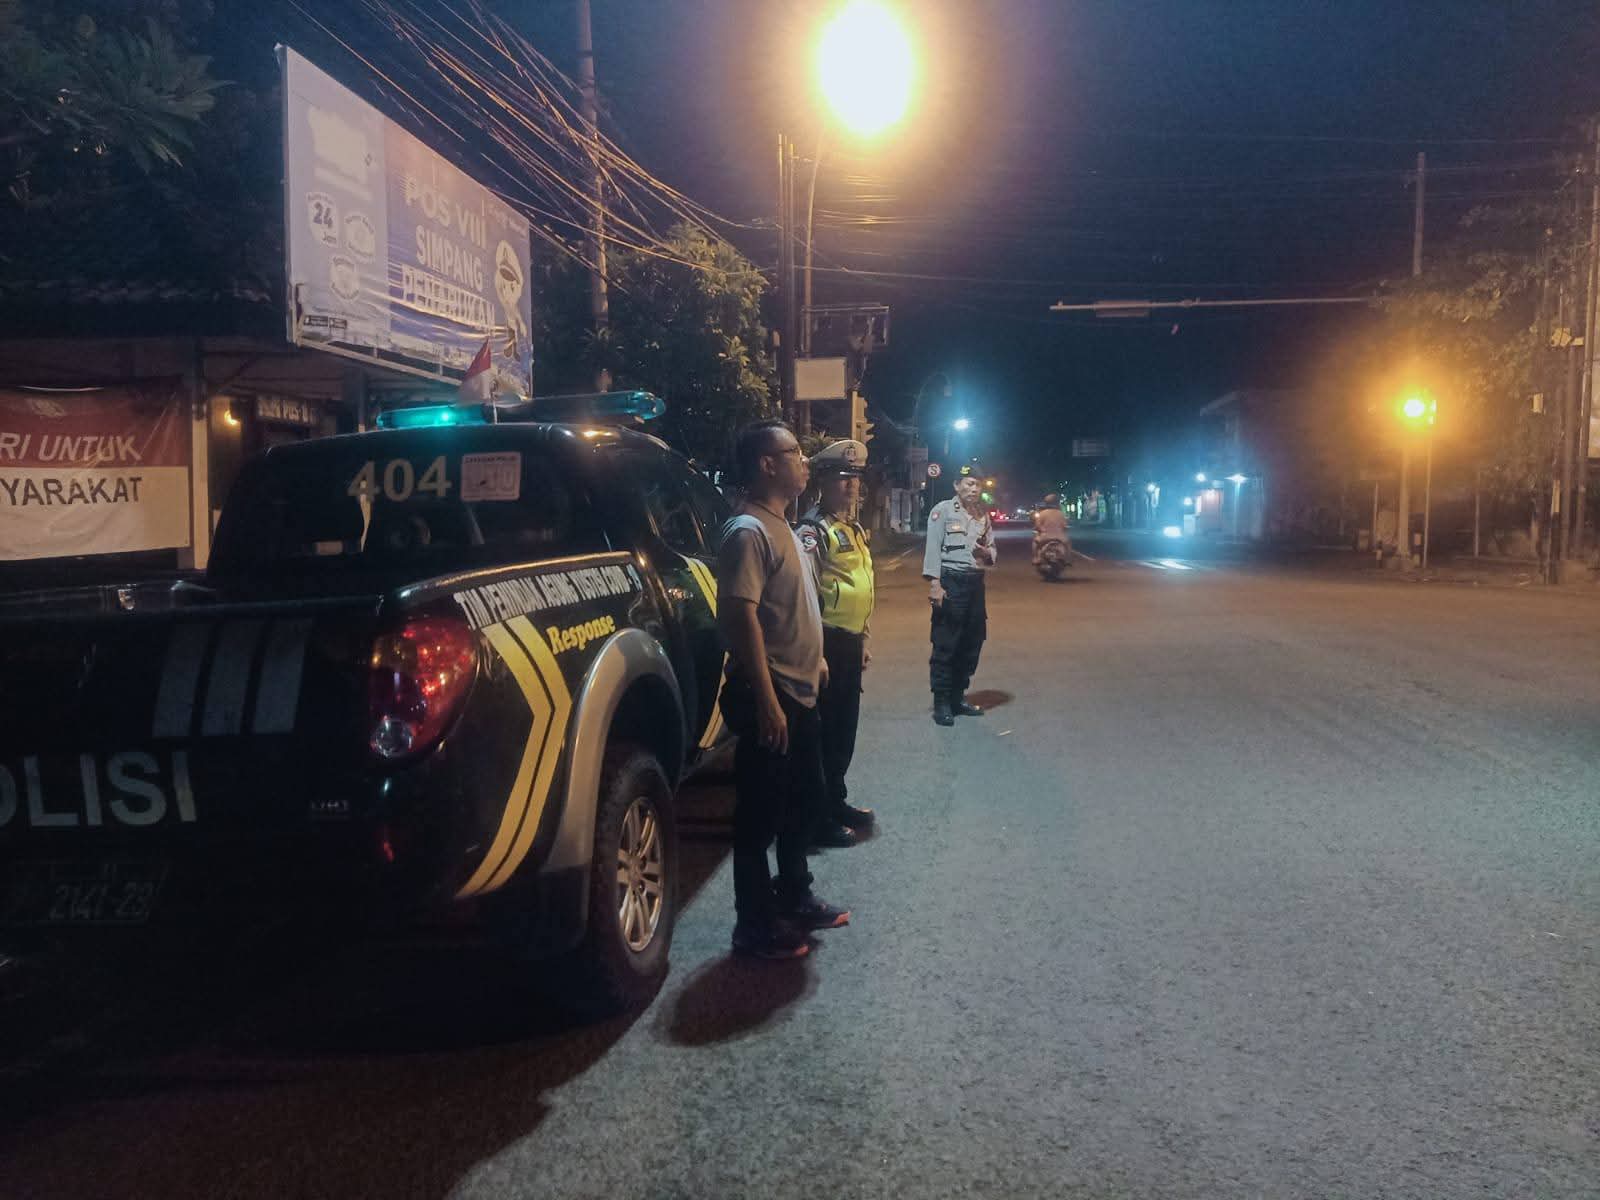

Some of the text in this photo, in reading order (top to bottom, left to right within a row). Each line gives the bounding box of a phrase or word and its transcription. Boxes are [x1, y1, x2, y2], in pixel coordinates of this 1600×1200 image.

[312, 201, 333, 228] 24
[404, 176, 450, 227] POS
[416, 224, 483, 292] SIMPANG
[38, 434, 142, 462] UNTUK
[0, 476, 143, 506] YARAKAT
[347, 456, 452, 502] 404
[453, 588, 492, 631] TIM
[546, 615, 616, 655] Response
[0, 751, 197, 828] LISI
